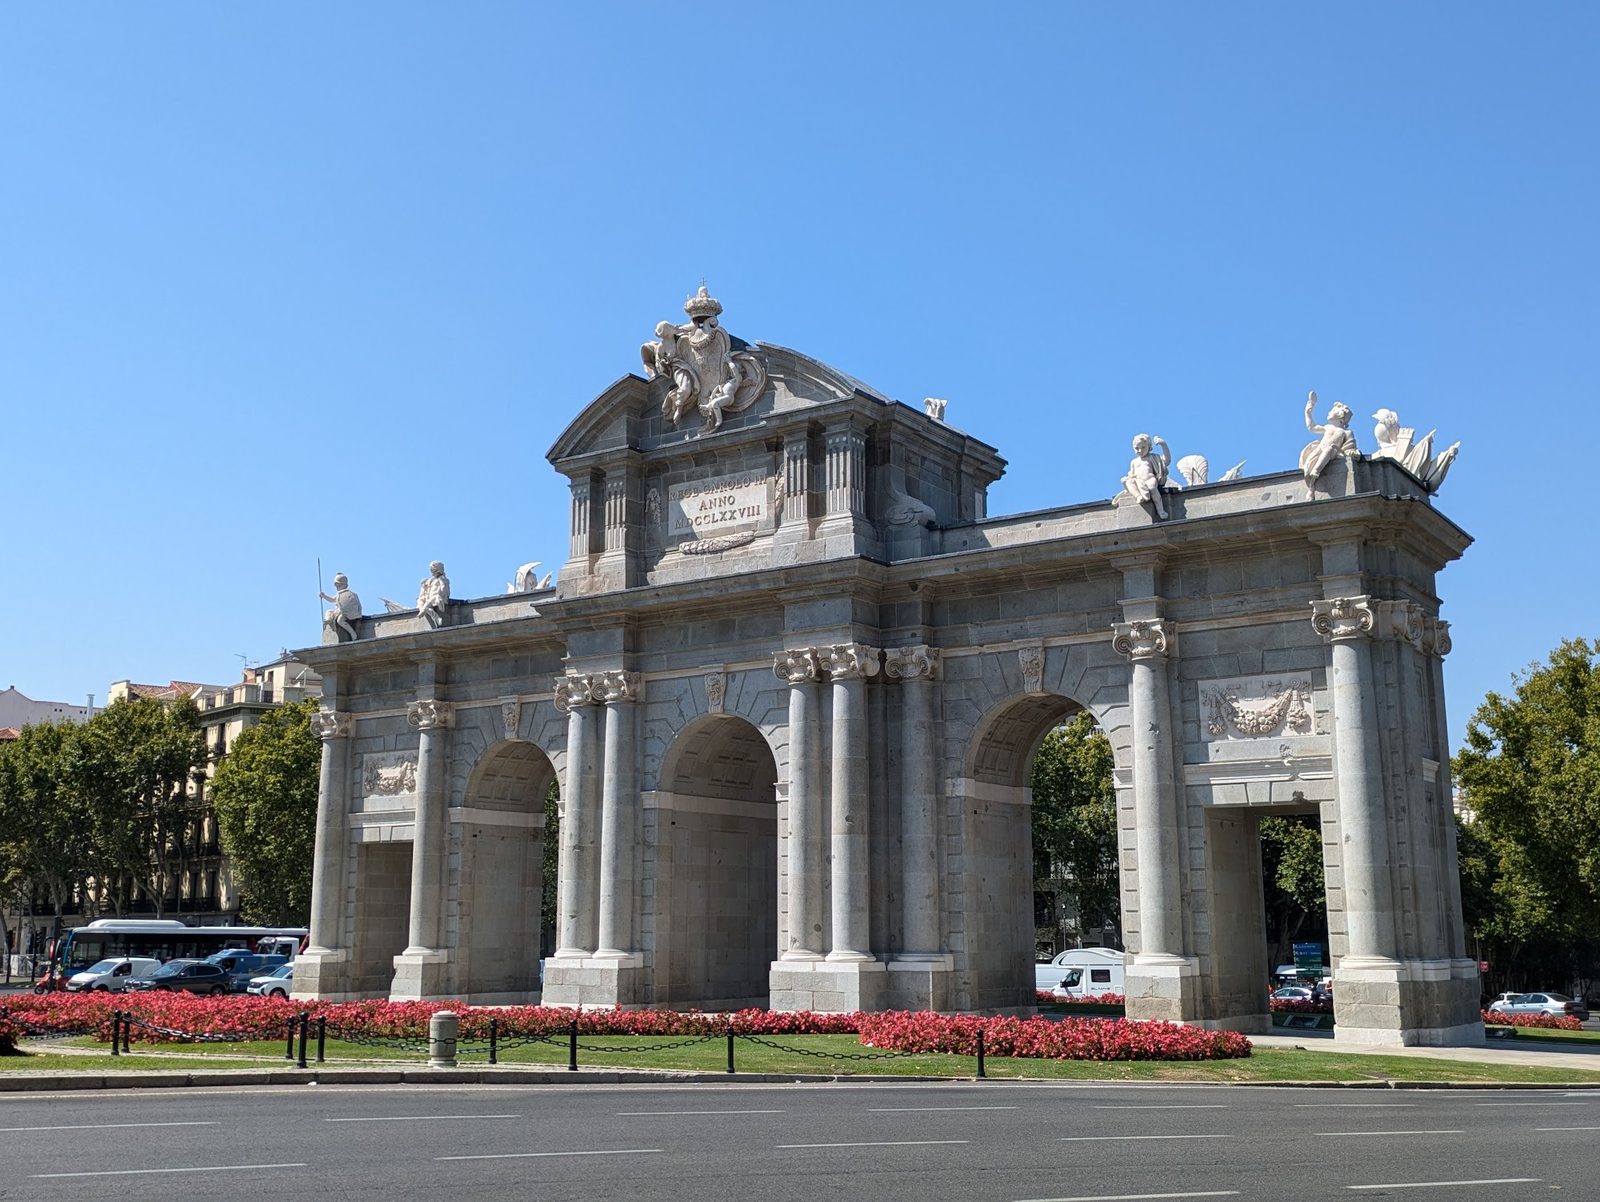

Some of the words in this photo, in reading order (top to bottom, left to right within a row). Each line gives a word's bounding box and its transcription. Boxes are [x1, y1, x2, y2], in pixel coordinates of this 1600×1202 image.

[703, 476, 751, 495] CAROLO
[754, 473, 767, 486] III
[699, 495, 736, 511] ANNO
[675, 505, 760, 529] MDCCLXXVIII
